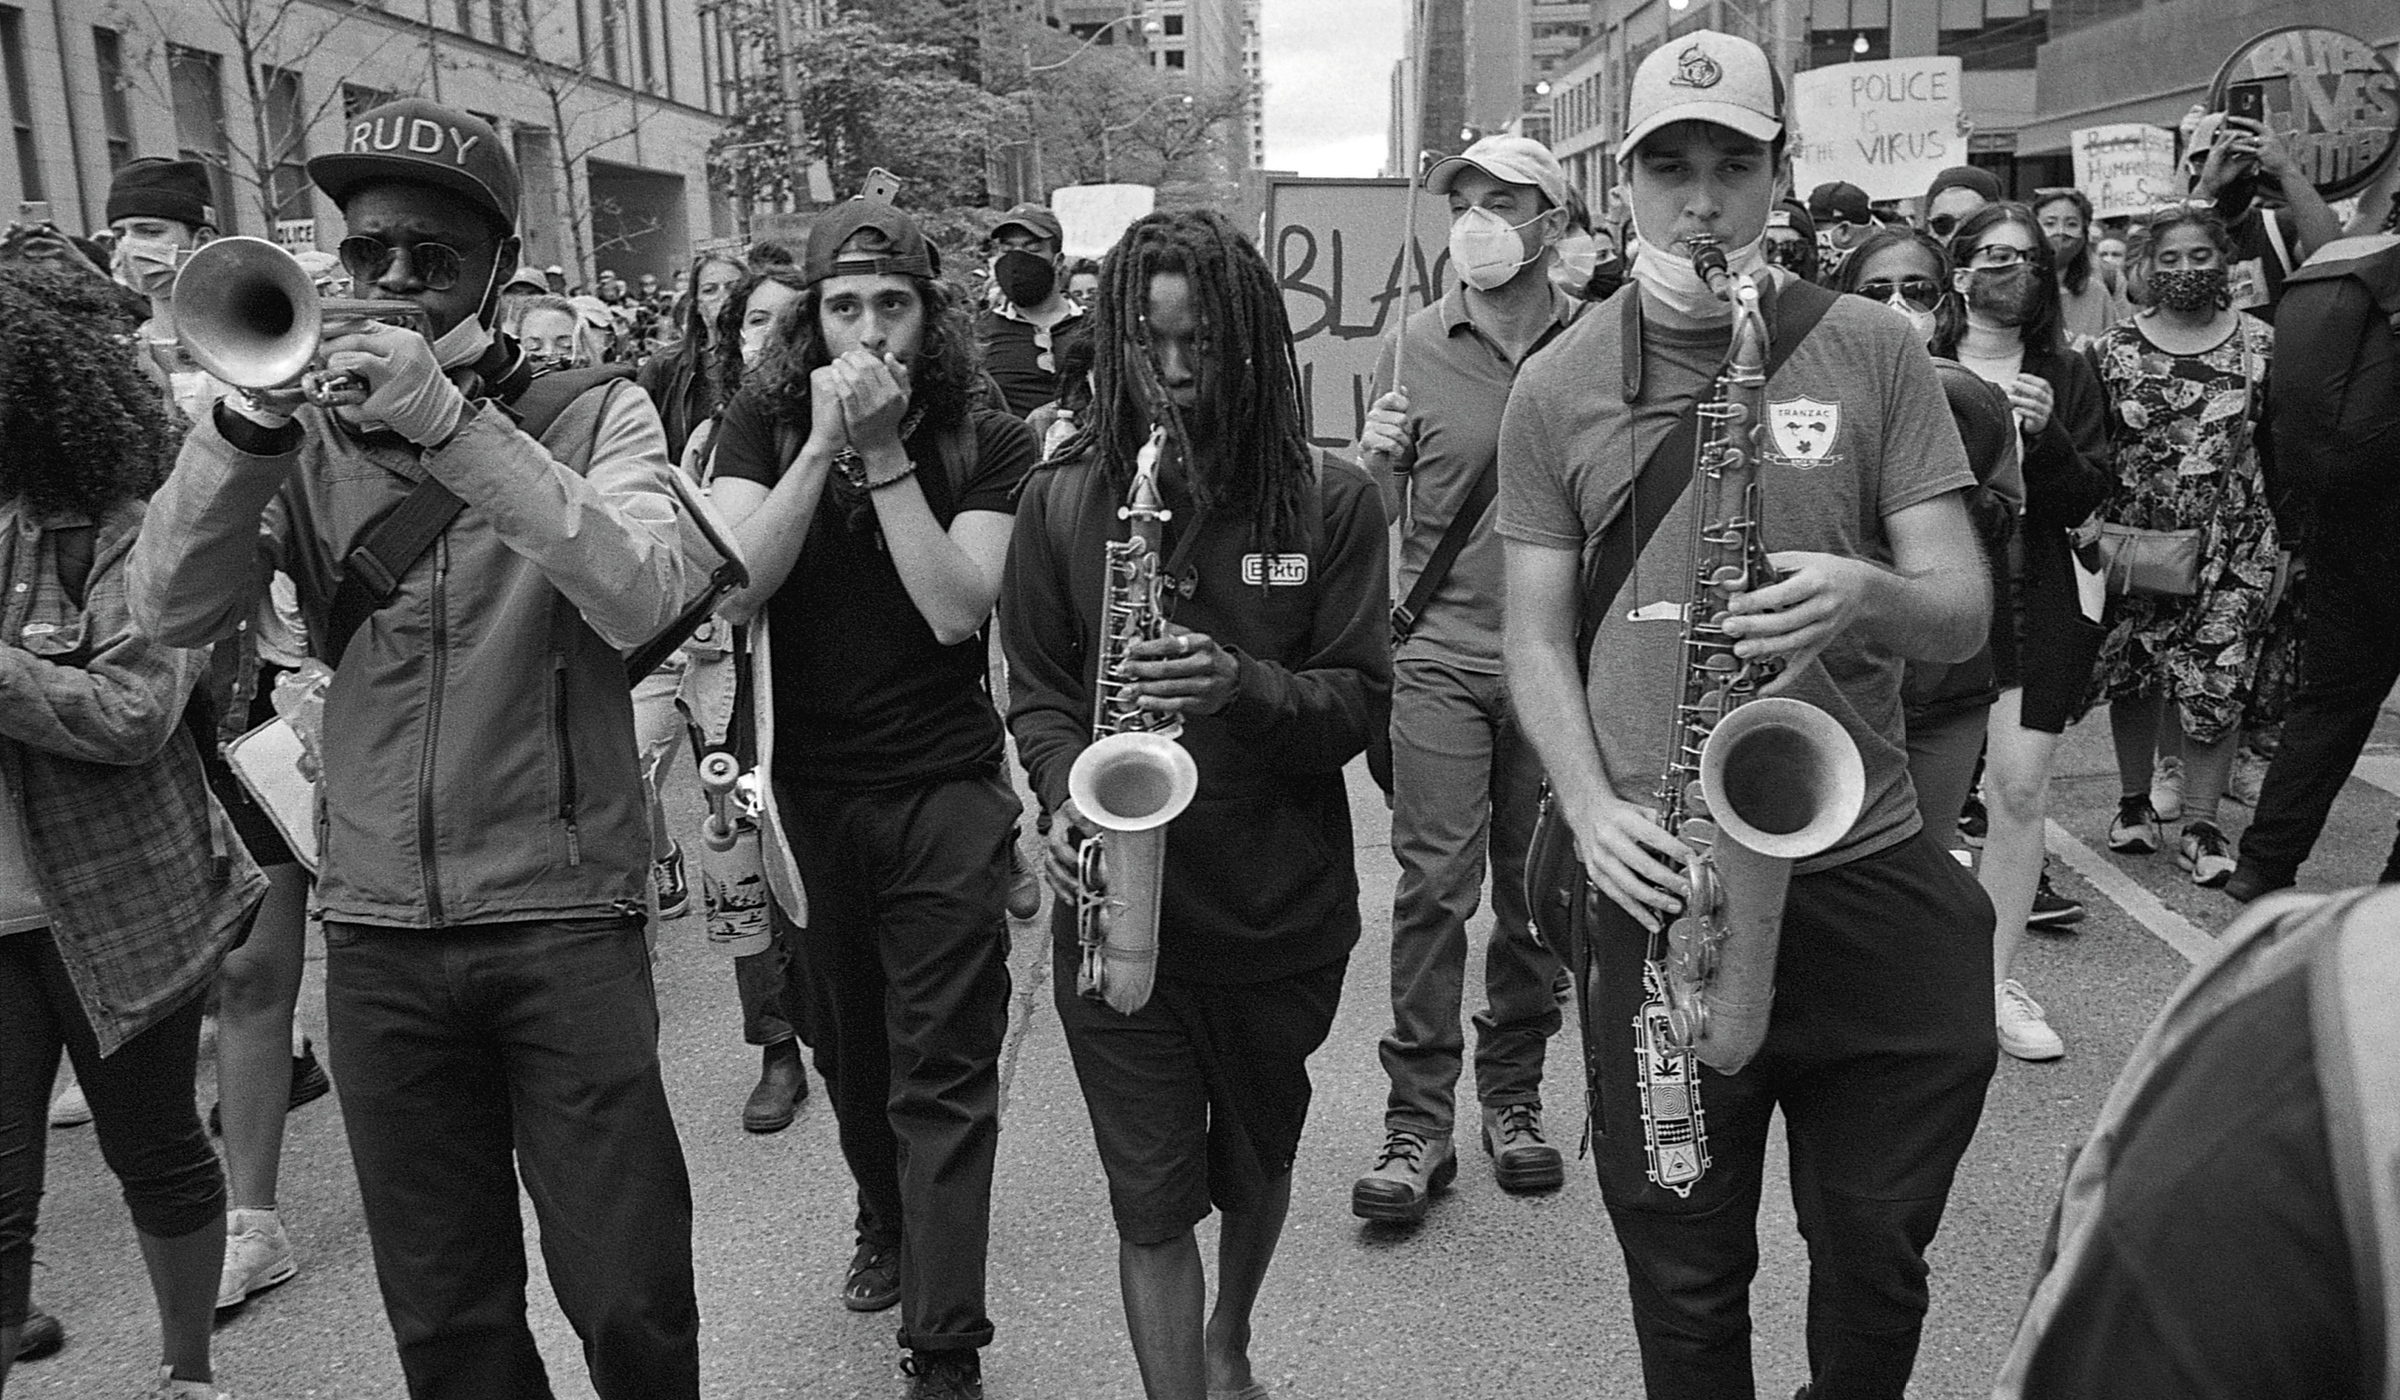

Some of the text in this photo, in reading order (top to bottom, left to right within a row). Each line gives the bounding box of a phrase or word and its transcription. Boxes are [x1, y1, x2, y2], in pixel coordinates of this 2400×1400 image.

[1852, 71, 1948, 107] POLICE
[351, 116, 479, 164] RUDY
[1856, 130, 1947, 165] VIRUS
[277, 225, 313, 244] OLICE
[1778, 408, 1830, 418] TRANZAC
